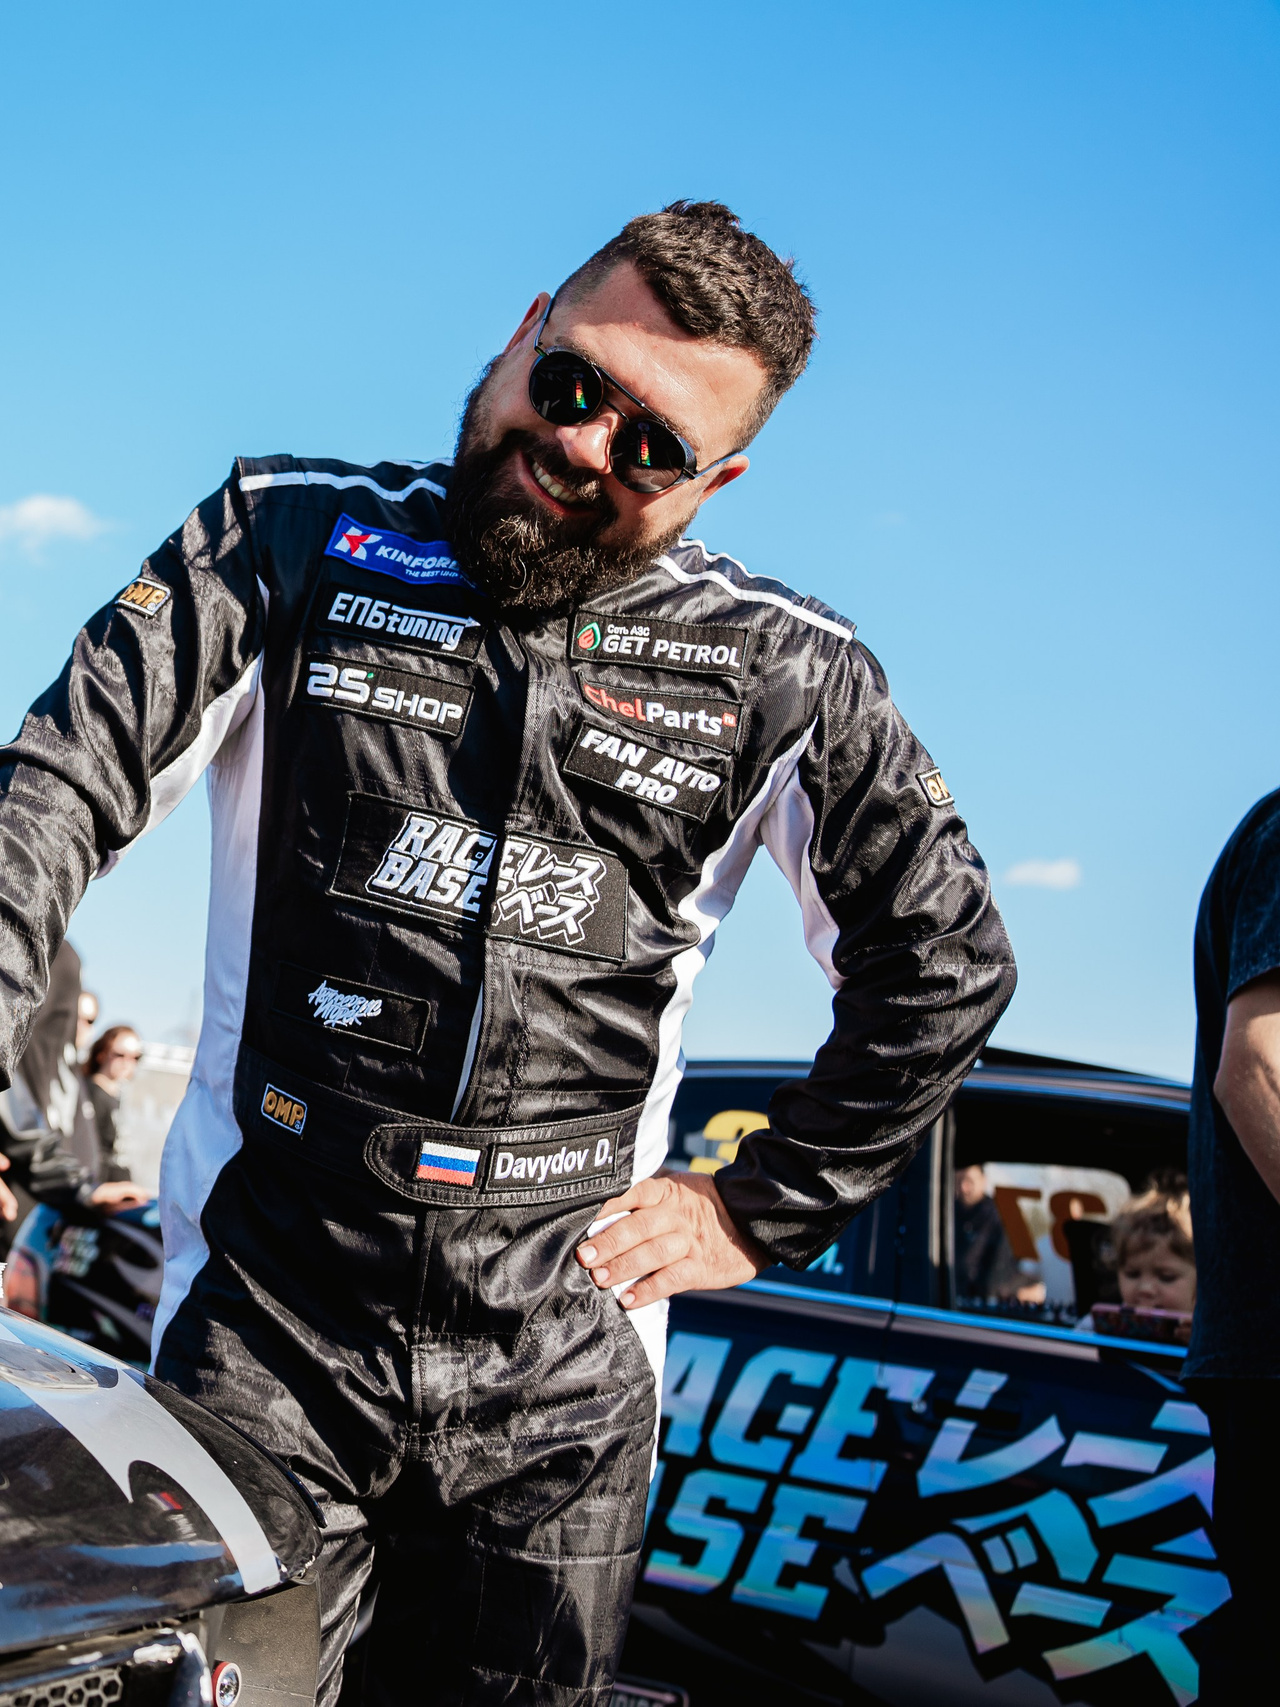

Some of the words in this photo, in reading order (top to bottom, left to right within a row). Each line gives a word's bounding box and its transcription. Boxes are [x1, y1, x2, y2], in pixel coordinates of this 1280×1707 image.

[405, 569, 420, 578] THE
[420, 570, 441, 578] BEST
[602, 634, 650, 656] GET
[651, 638, 741, 668] PETROL
[371, 686, 463, 725] SHOP
[584, 684, 723, 736] ChelParts
[579, 728, 648, 767] FAN
[649, 756, 721, 792] AVTO
[614, 769, 678, 804] PRO
[264, 1091, 305, 1126] OMP
[494, 1146, 590, 1183] Davydov
[594, 1138, 613, 1167] D.
[661, 1331, 936, 1492] ACE
